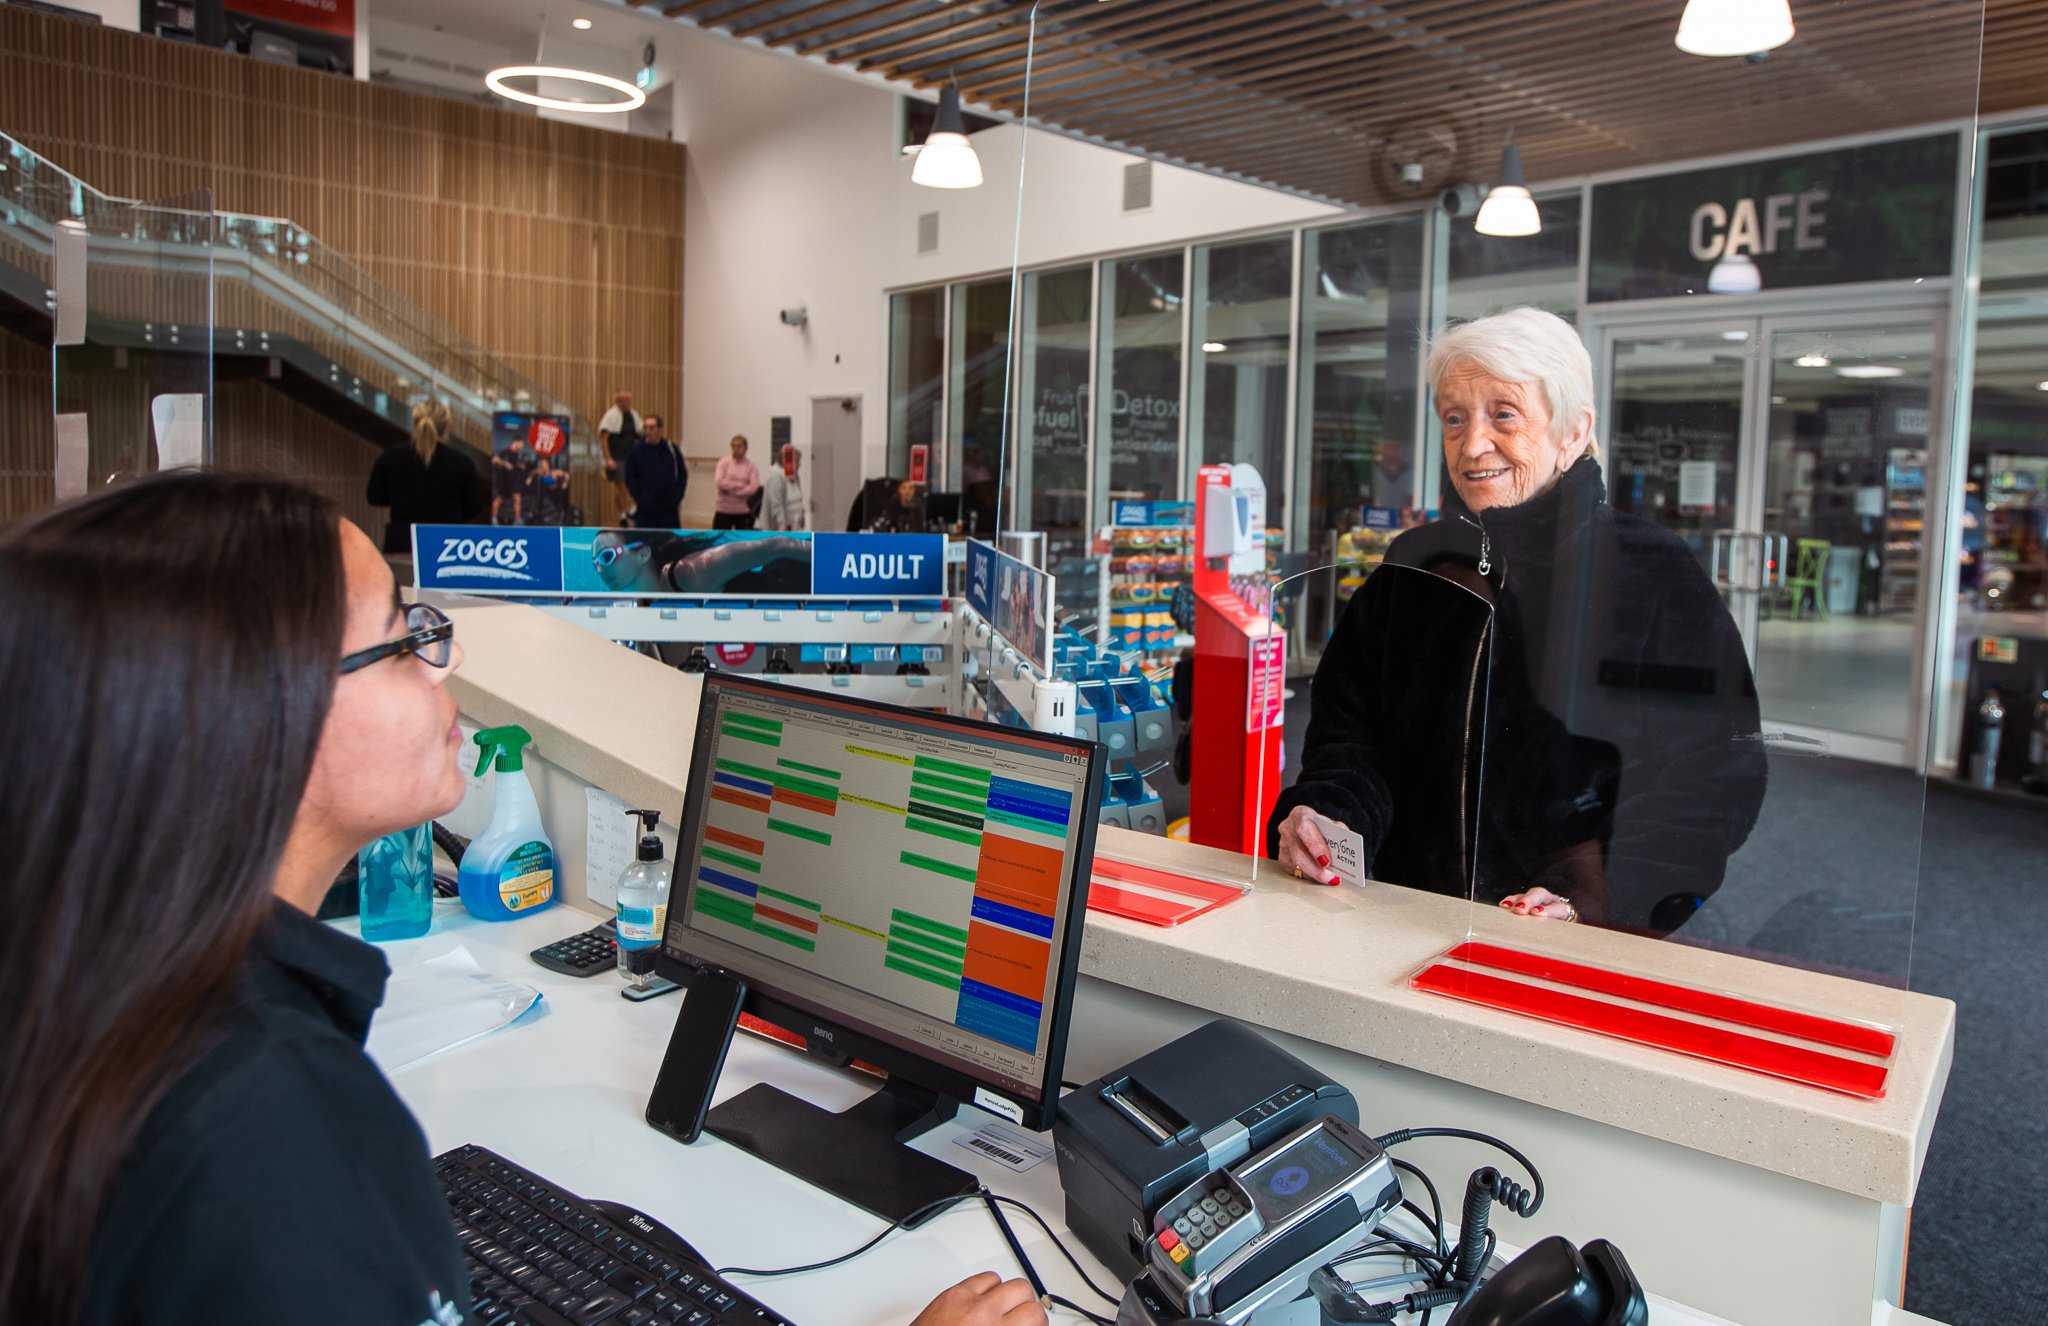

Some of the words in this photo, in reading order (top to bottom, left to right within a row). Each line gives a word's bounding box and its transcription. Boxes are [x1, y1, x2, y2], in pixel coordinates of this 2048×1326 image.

[1112, 389, 1180, 417] Detox
[437, 539, 529, 570] ZOGGS
[841, 553, 924, 580] ADULT
[1325, 838, 1356, 858] veryone
[1337, 854, 1356, 868] ACTIVE
